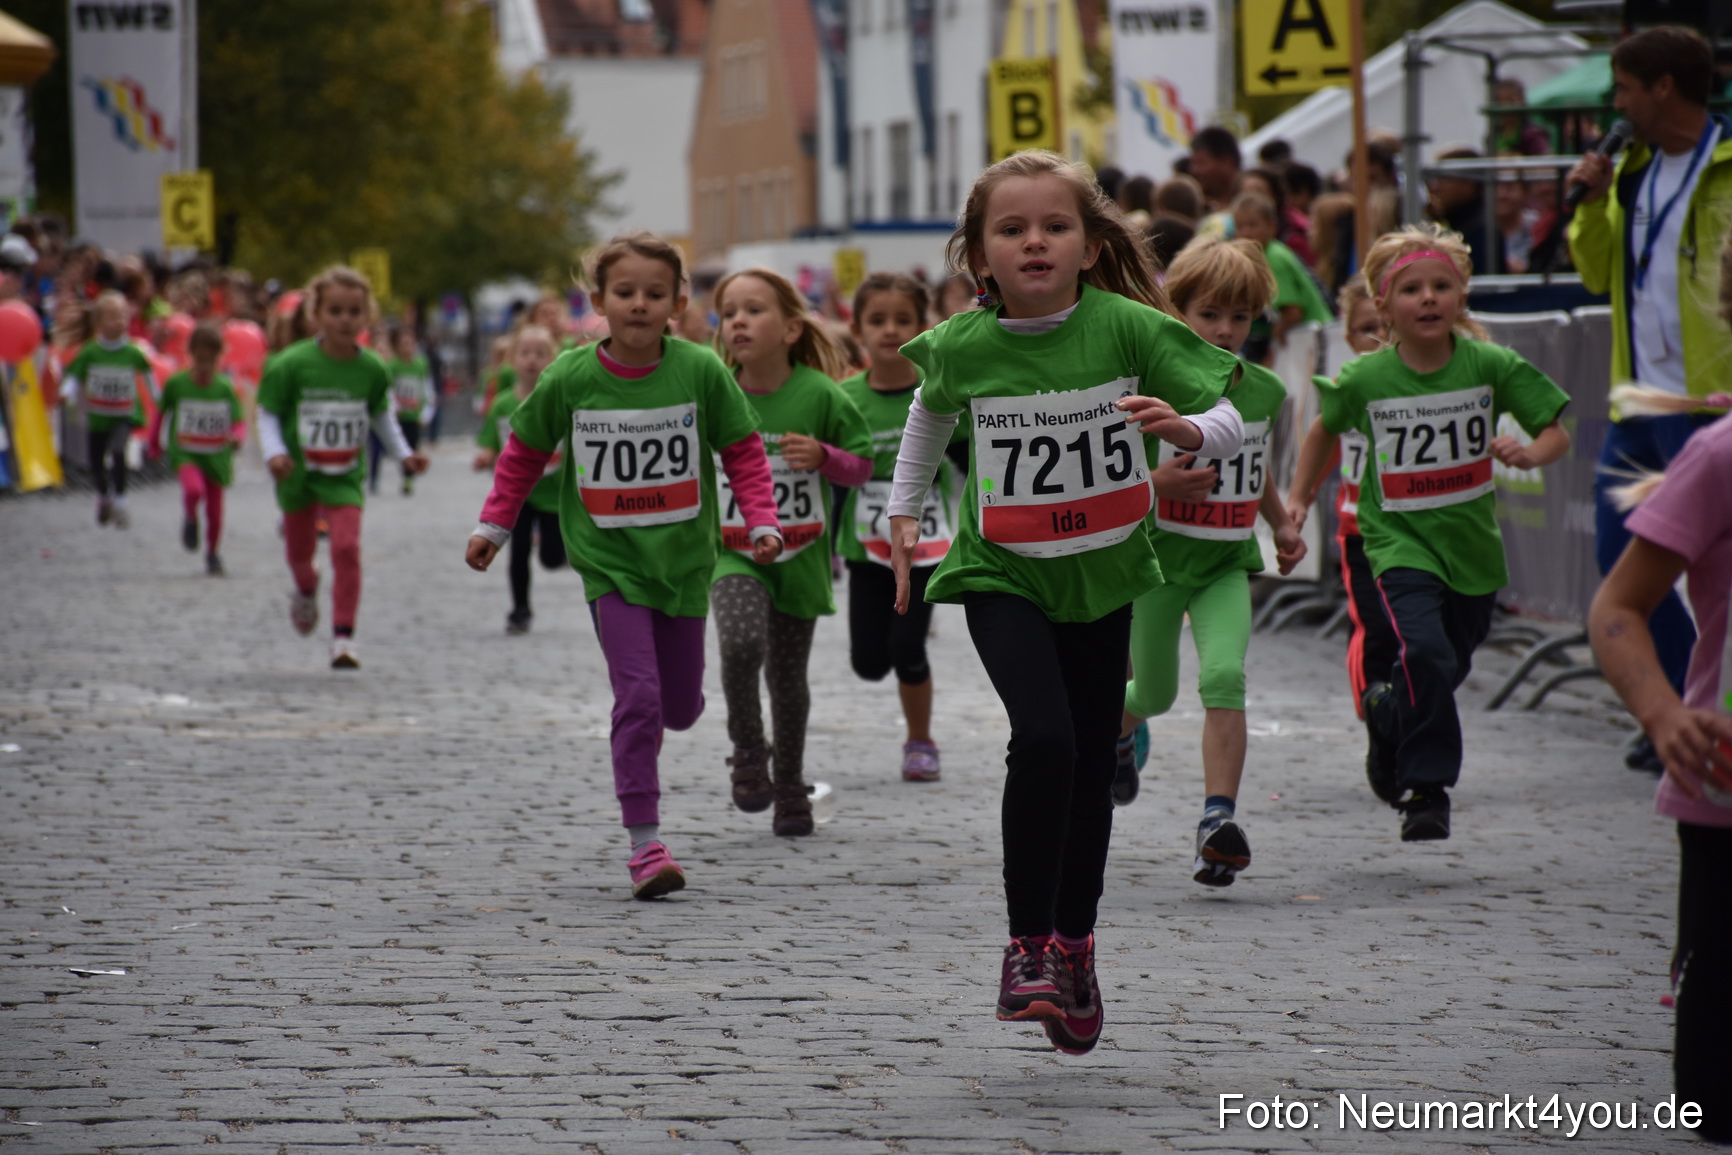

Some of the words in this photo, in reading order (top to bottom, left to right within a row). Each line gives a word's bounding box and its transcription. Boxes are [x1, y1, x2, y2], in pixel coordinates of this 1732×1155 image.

[1272, 0, 1335, 51] A
[1009, 92, 1044, 140] B
[172, 195, 200, 232] C
[978, 413, 1031, 428] PARTL
[1035, 402, 1114, 427] Neumarkt
[1374, 410, 1413, 421] PARTL
[1416, 402, 1475, 418] Neumarkt
[575, 422, 615, 433] PARTL
[618, 420, 678, 433] Neumarkt
[1386, 415, 1486, 467] 7219
[585, 434, 689, 483] 7029
[991, 421, 1133, 497] 7215
[1135, 470, 1142, 480] K
[1407, 473, 1473, 494] Johanna
[614, 493, 666, 511] Anouk
[722, 480, 812, 520] 725
[985, 494, 991, 505] 1
[1052, 510, 1087, 534] Ida
